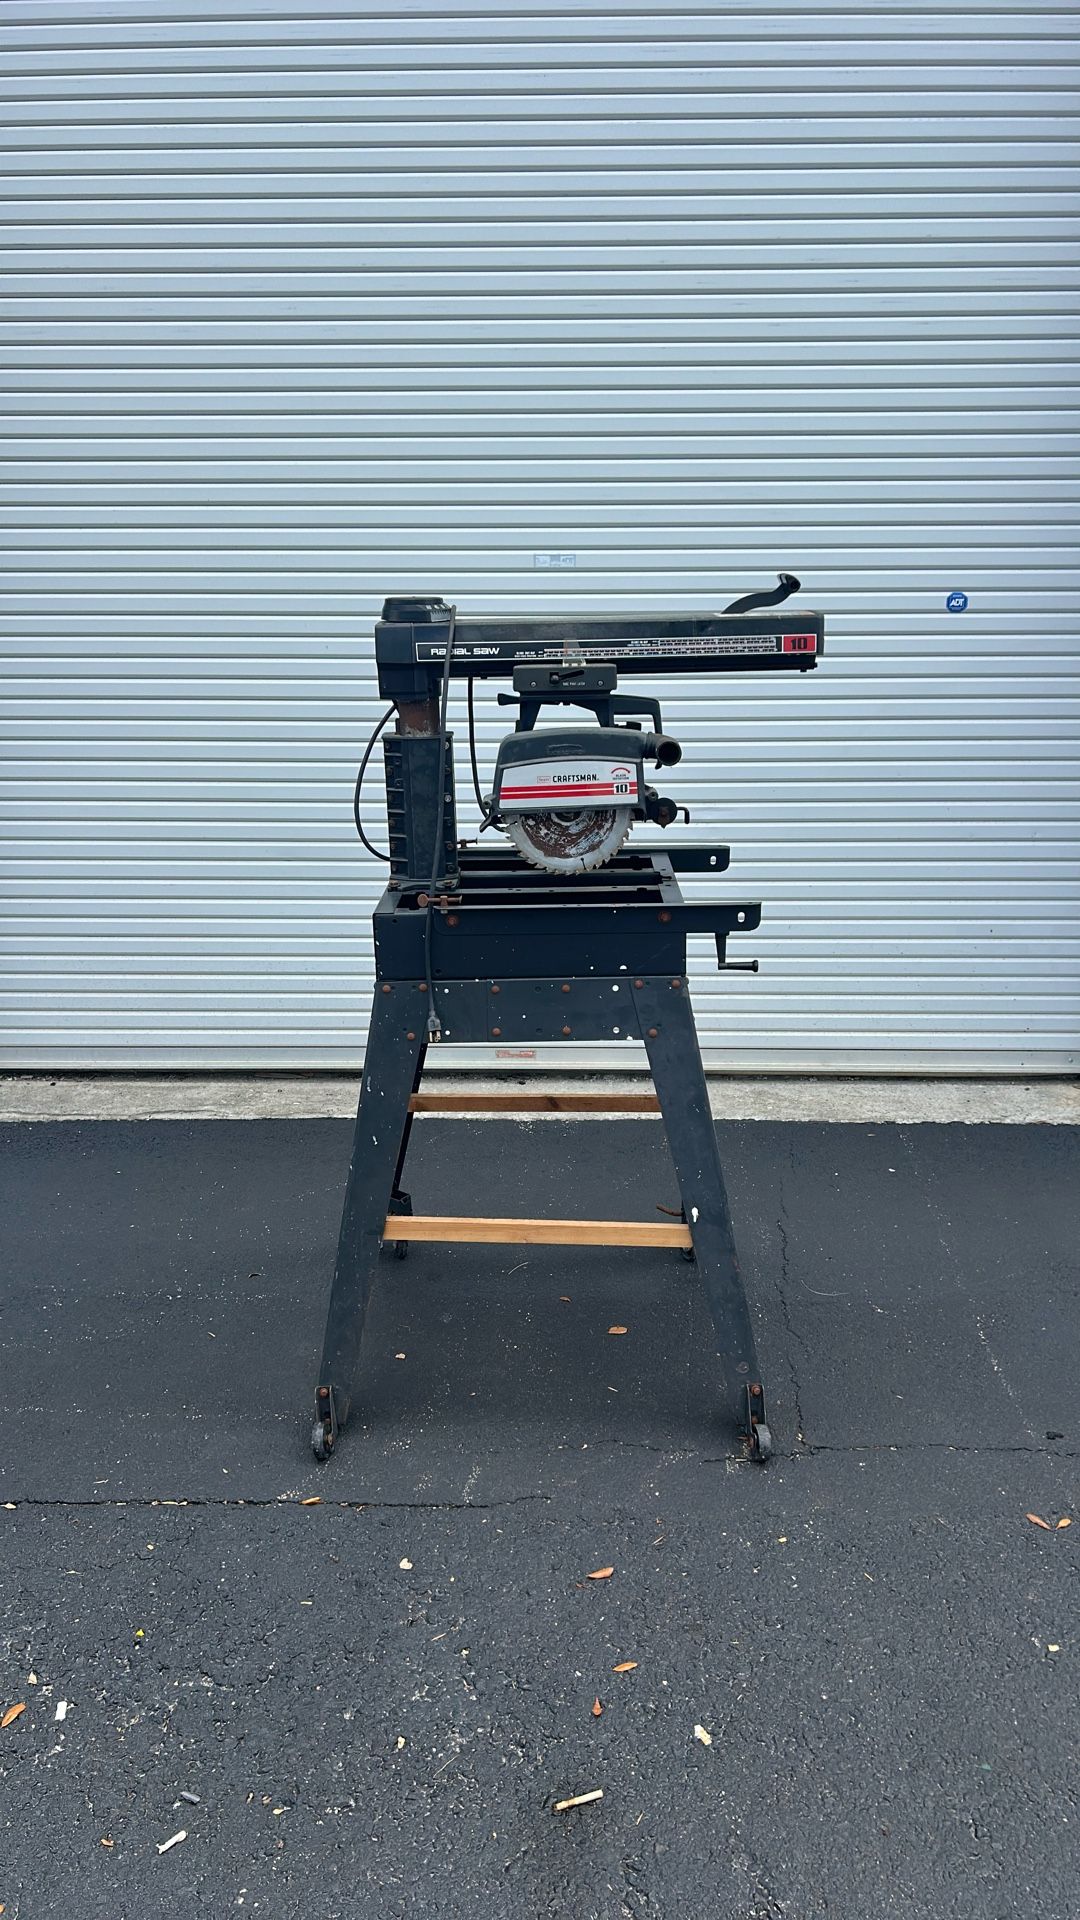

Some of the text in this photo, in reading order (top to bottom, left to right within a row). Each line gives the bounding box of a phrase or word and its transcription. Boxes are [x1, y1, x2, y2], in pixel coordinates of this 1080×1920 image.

[949, 598, 964, 606] ADT
[791, 637, 807, 650] 10
[552, 774, 597, 783] CRAFTSMAN
[615, 784, 628, 793] 10
